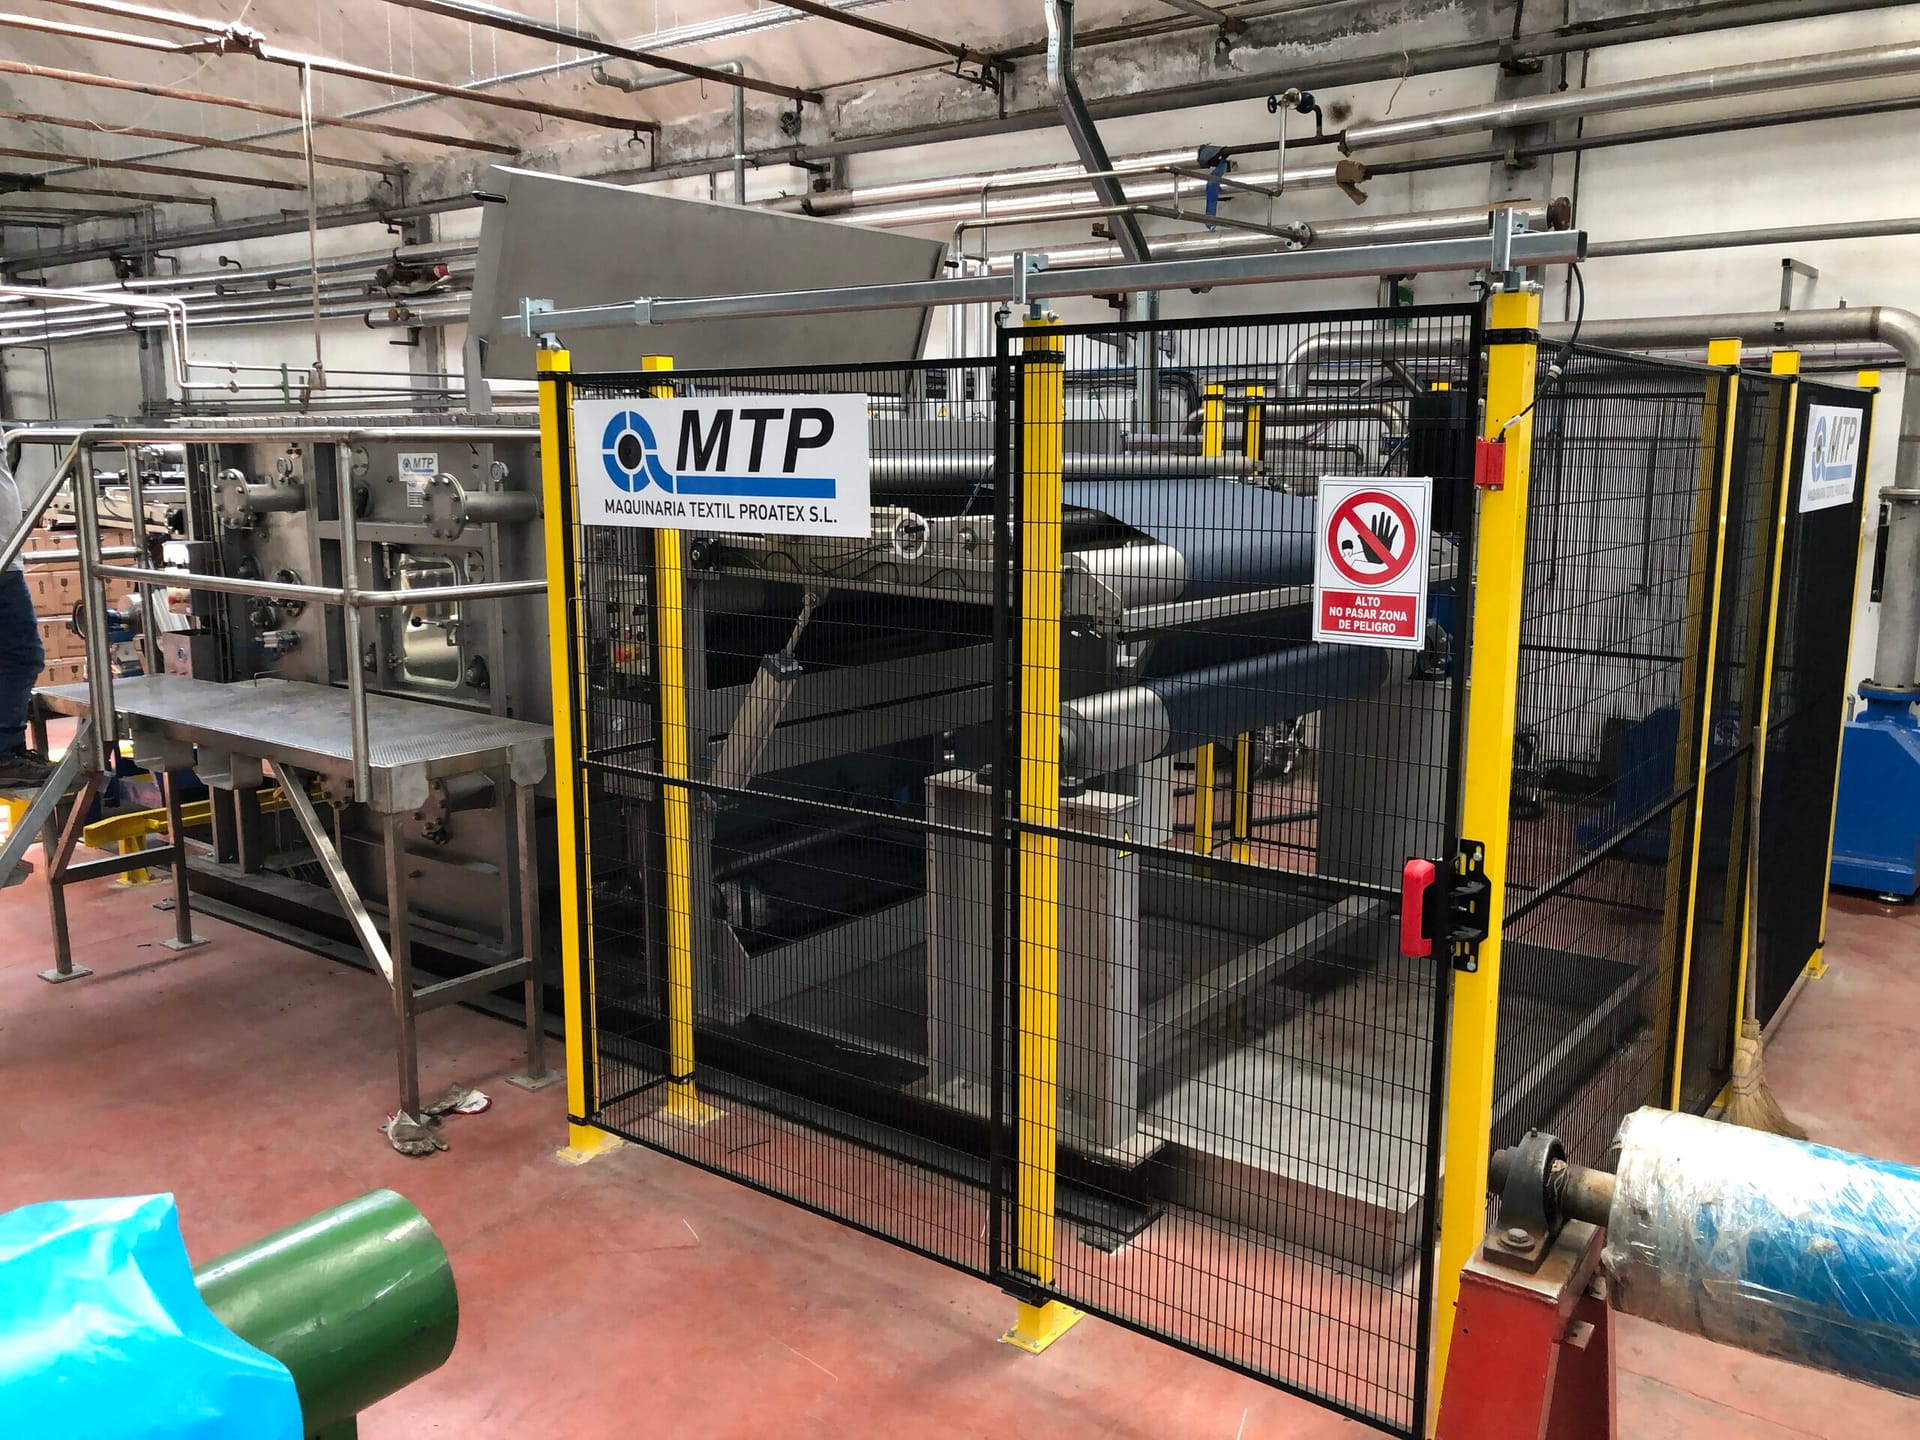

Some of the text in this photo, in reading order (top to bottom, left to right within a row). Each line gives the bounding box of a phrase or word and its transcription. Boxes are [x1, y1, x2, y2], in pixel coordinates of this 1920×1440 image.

[676, 407, 835, 473] MTP
[1827, 416, 1857, 463] MTP
[413, 458, 433, 468] MTP
[605, 499, 838, 523] MAQUINARIA TEXTIL PROATEX S.L.
[1355, 596, 1380, 607] ALTO
[1329, 606, 1407, 621] NO PASAR ZONA
[1339, 619, 1396, 633] DE PELIGRO
